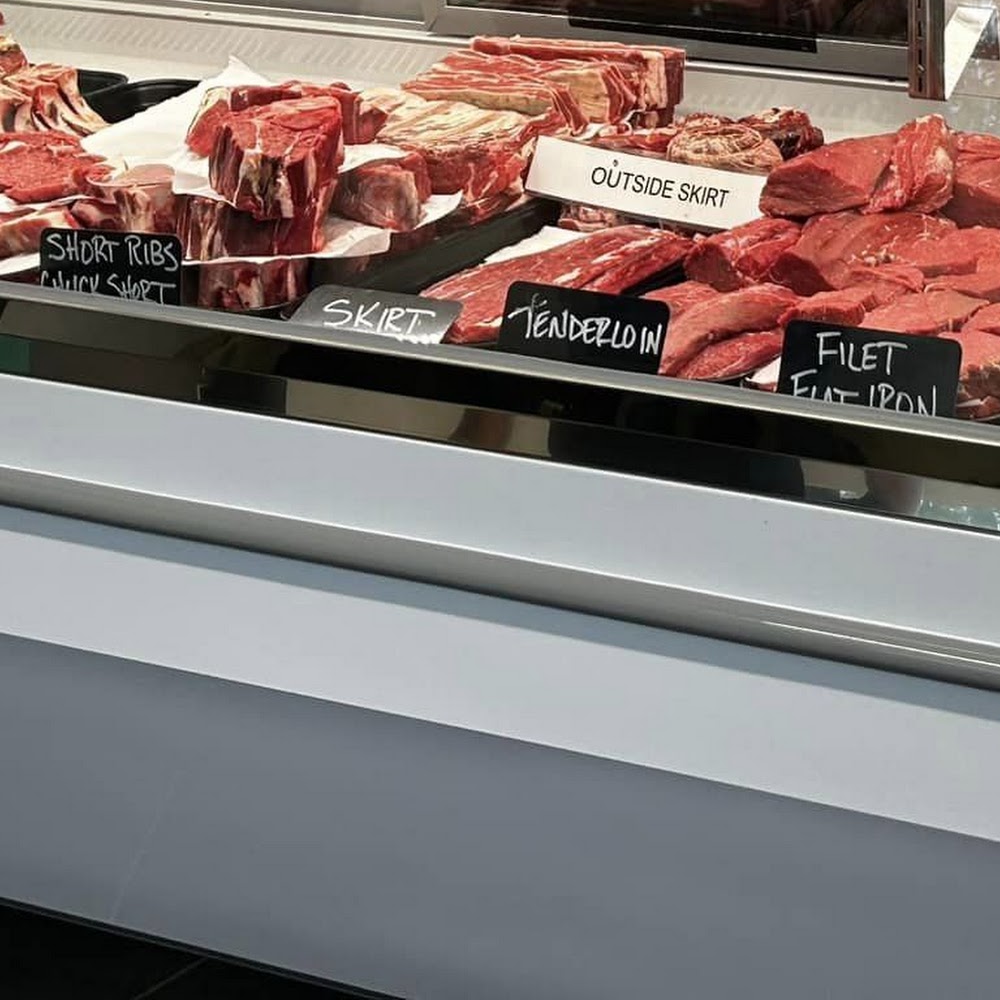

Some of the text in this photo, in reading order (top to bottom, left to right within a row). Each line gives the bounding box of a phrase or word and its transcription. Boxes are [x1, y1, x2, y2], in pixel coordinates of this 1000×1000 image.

[591, 166, 730, 208] OUTSIDE SKIRT
[46, 231, 179, 272] SHORT RIBS
[106, 273, 176, 306] SHORT
[323, 299, 436, 335] SKIRT
[508, 304, 662, 355] TENDERLOIN
[816, 332, 908, 375] FILET
[869, 382, 936, 417] IRON
